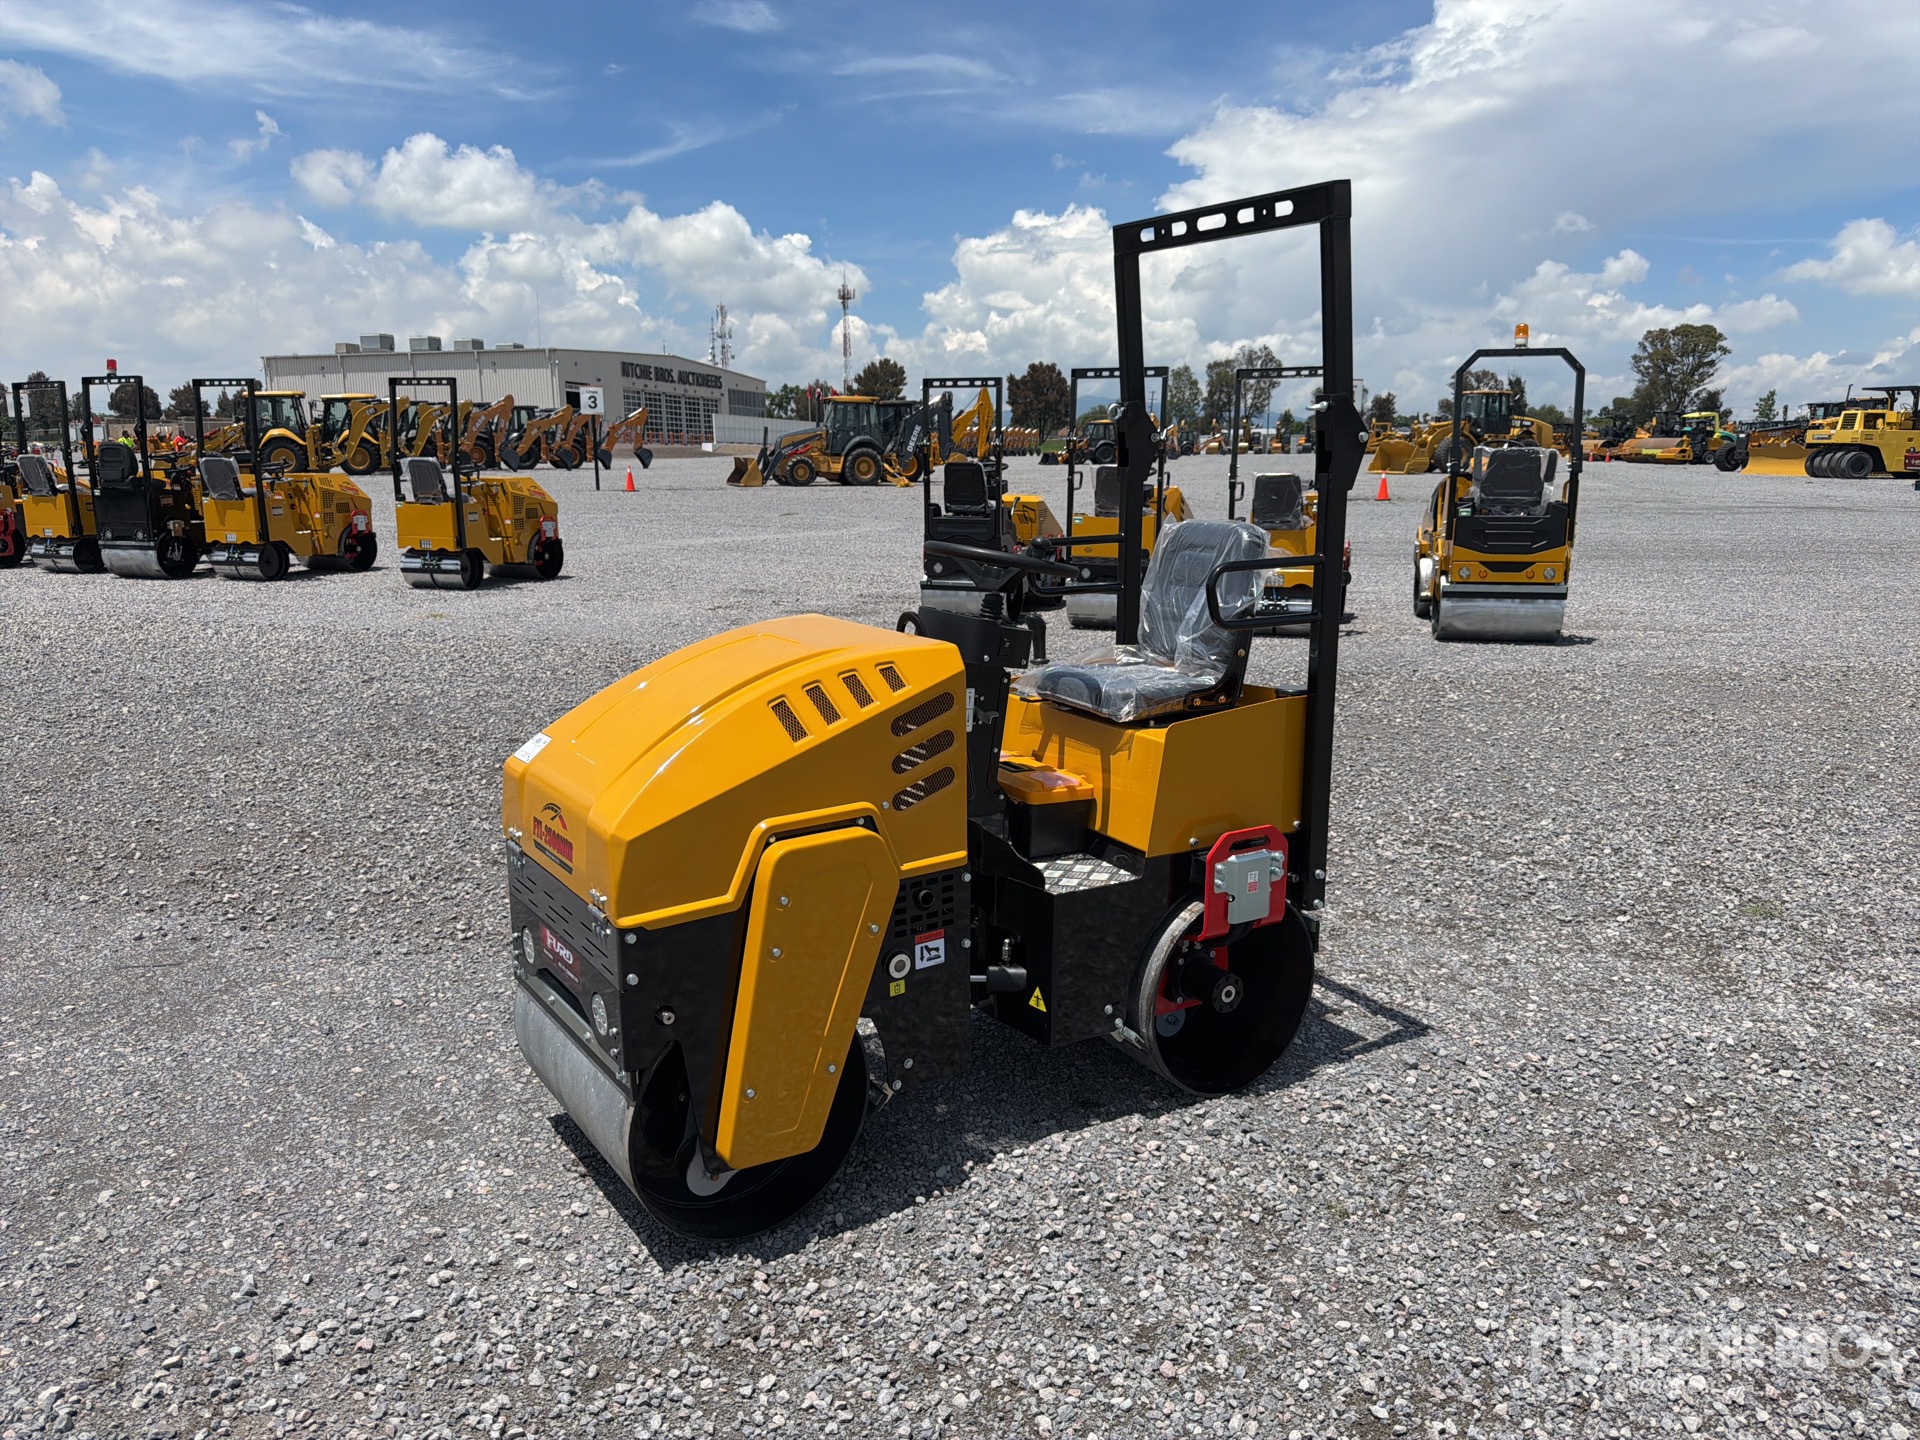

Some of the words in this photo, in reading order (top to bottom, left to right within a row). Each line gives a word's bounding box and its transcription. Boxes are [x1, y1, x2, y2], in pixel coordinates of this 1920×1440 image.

[621, 361, 652, 381] RITCHIE
[653, 366, 676, 385] BROS.
[677, 369, 723, 390] AUCTIONEERS
[588, 395, 598, 409] 3
[472, 414, 486, 431] CASE
[615, 424, 628, 437] CASE
[906, 424, 922, 453] DEERE
[546, 929, 574, 965] FURD
